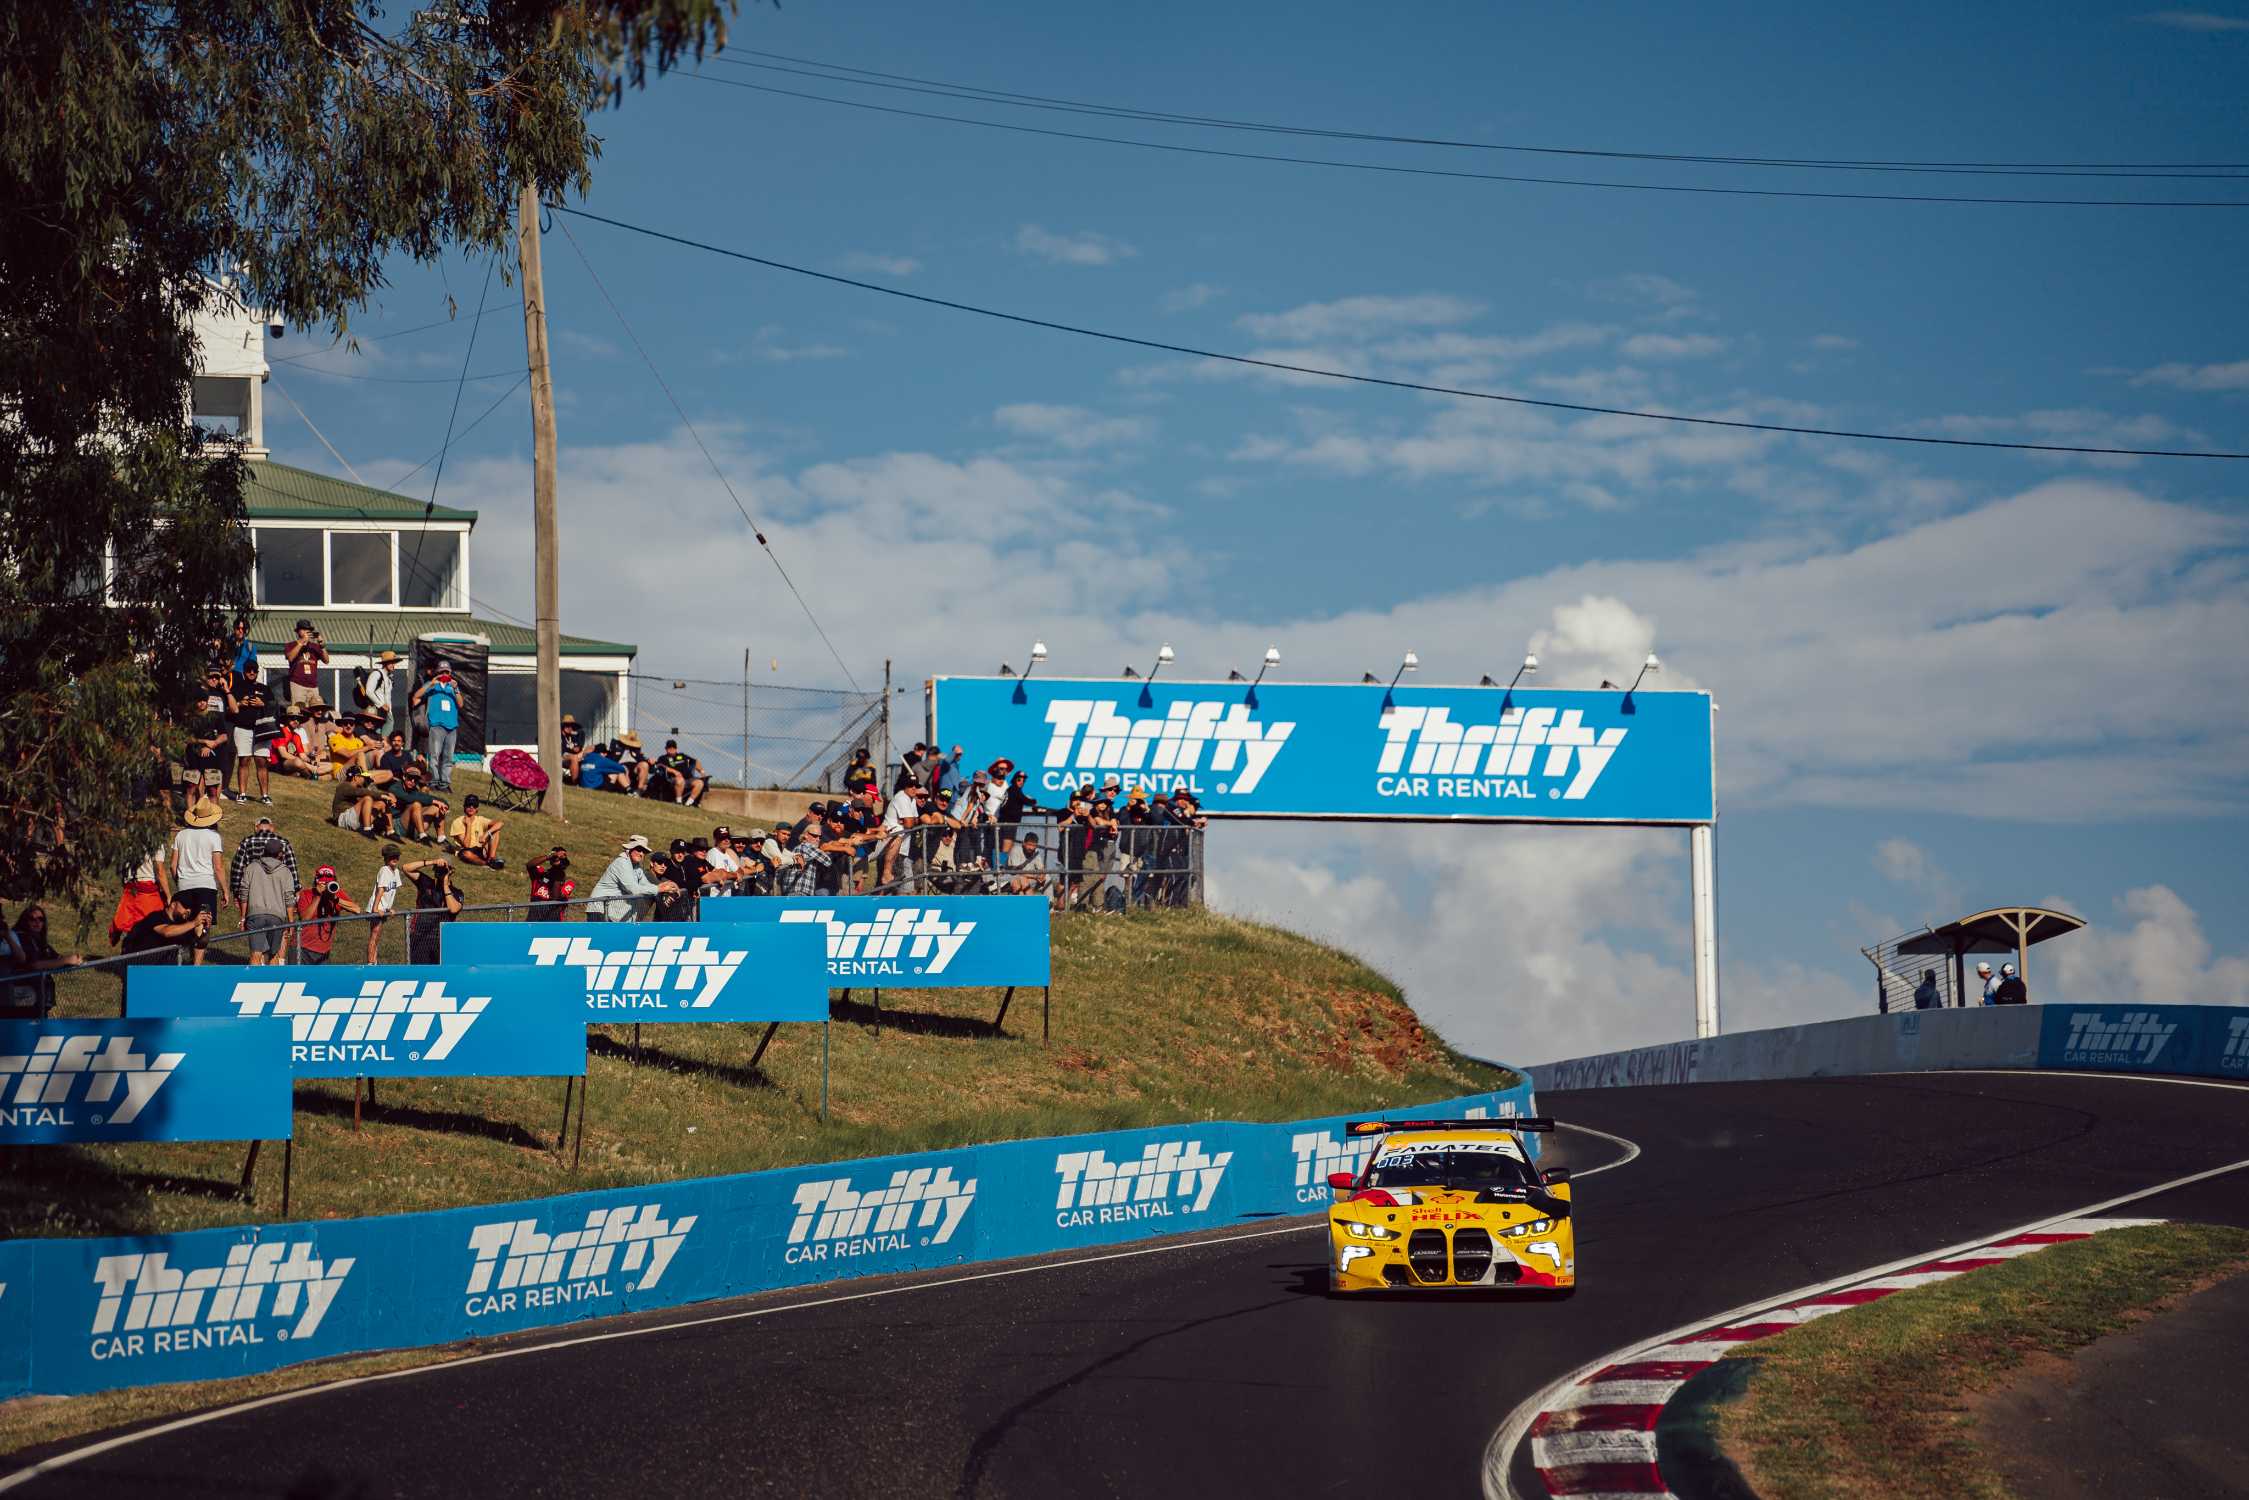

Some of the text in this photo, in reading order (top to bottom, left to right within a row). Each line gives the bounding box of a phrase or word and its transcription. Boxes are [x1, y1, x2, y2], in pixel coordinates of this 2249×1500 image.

[1042, 700, 1296, 794] Thrifty
[1377, 706, 1628, 800] Thrifty
[1042, 771, 1096, 792] CAR
[1376, 776, 1537, 799] CAR RENTAL
[528, 936, 749, 1008] Thrifty
[827, 961, 903, 975] RENTAL
[229, 980, 493, 1060] Thrifty
[291, 1045, 395, 1061] RENTAL
[2063, 1012, 2178, 1064] Thrifty
[2063, 1050, 2130, 1064] CAR RENTAL
[1377, 1155, 1414, 1169] 003
[1384, 1144, 1512, 1156] FANATEC
[1055, 1140, 1233, 1212] Thrifty
[787, 1166, 978, 1245] Thrifty
[1296, 1186, 1328, 1203] CAR
[1056, 1201, 1173, 1229] CAR RENTAL
[1411, 1212, 1482, 1221] HELIX
[465, 1204, 698, 1293] Thrifty
[785, 1233, 911, 1265] CAR RENTAL
[90, 1241, 356, 1339] Thrifty
[465, 1281, 613, 1317] CAR RENTAL
[91, 1325, 264, 1361] CAR RENTAL
